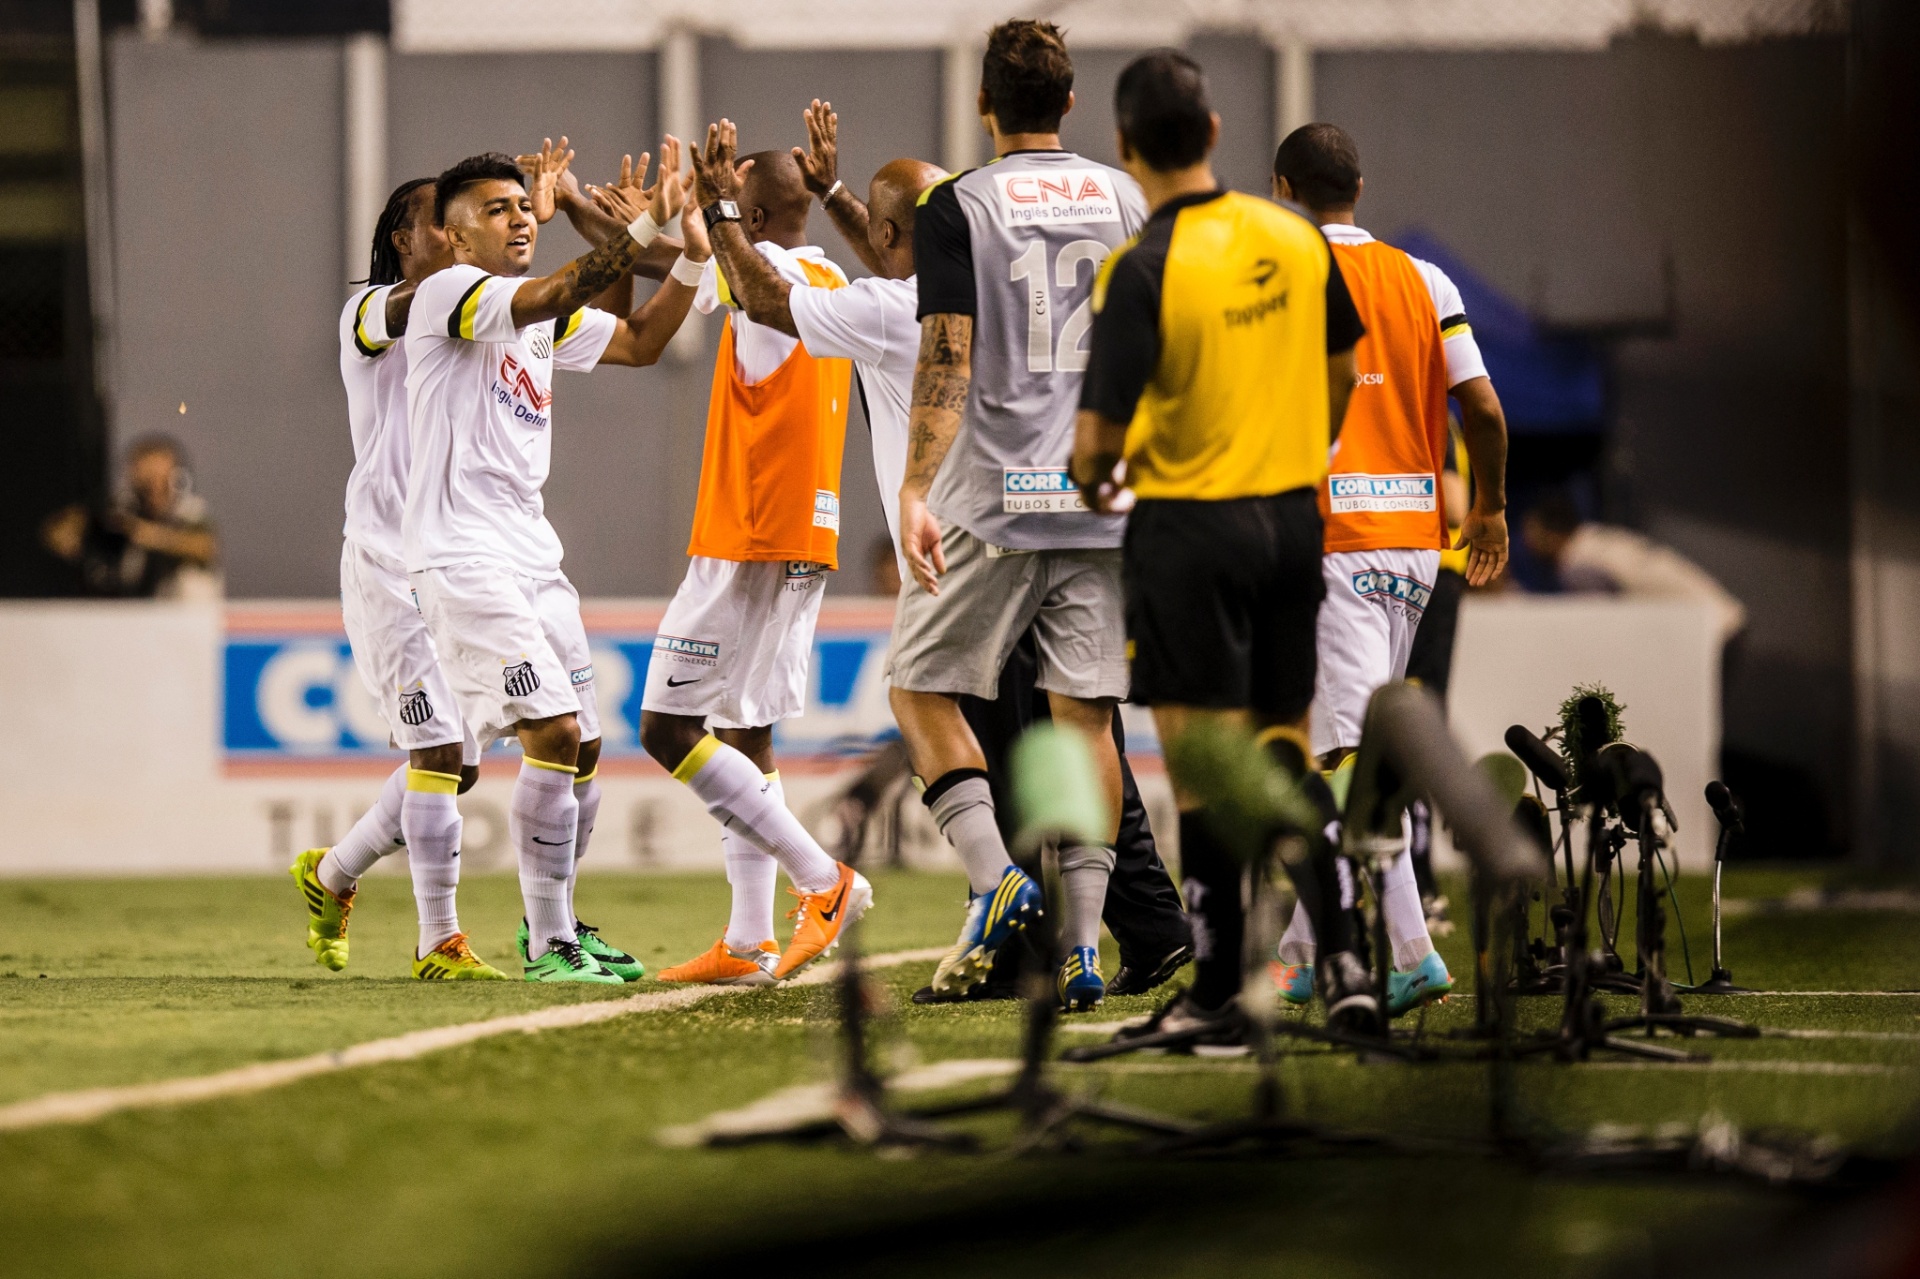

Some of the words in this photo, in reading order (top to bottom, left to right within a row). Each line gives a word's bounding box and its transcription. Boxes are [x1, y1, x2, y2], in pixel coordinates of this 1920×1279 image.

[1006, 175, 1108, 203] CNA
[1010, 207, 1049, 221] Inglês
[1052, 205, 1112, 218] Definitivo
[1010, 239, 1112, 373] 12
[1035, 290, 1045, 316] CSU
[1363, 373, 1384, 385] CSU
[1007, 473, 1063, 491] CORR
[1373, 480, 1428, 496] PLASTIK
[1006, 499, 1051, 510] TUBOS
[671, 639, 718, 656] PLASTIK
[672, 654, 717, 667] CONEXÕES
